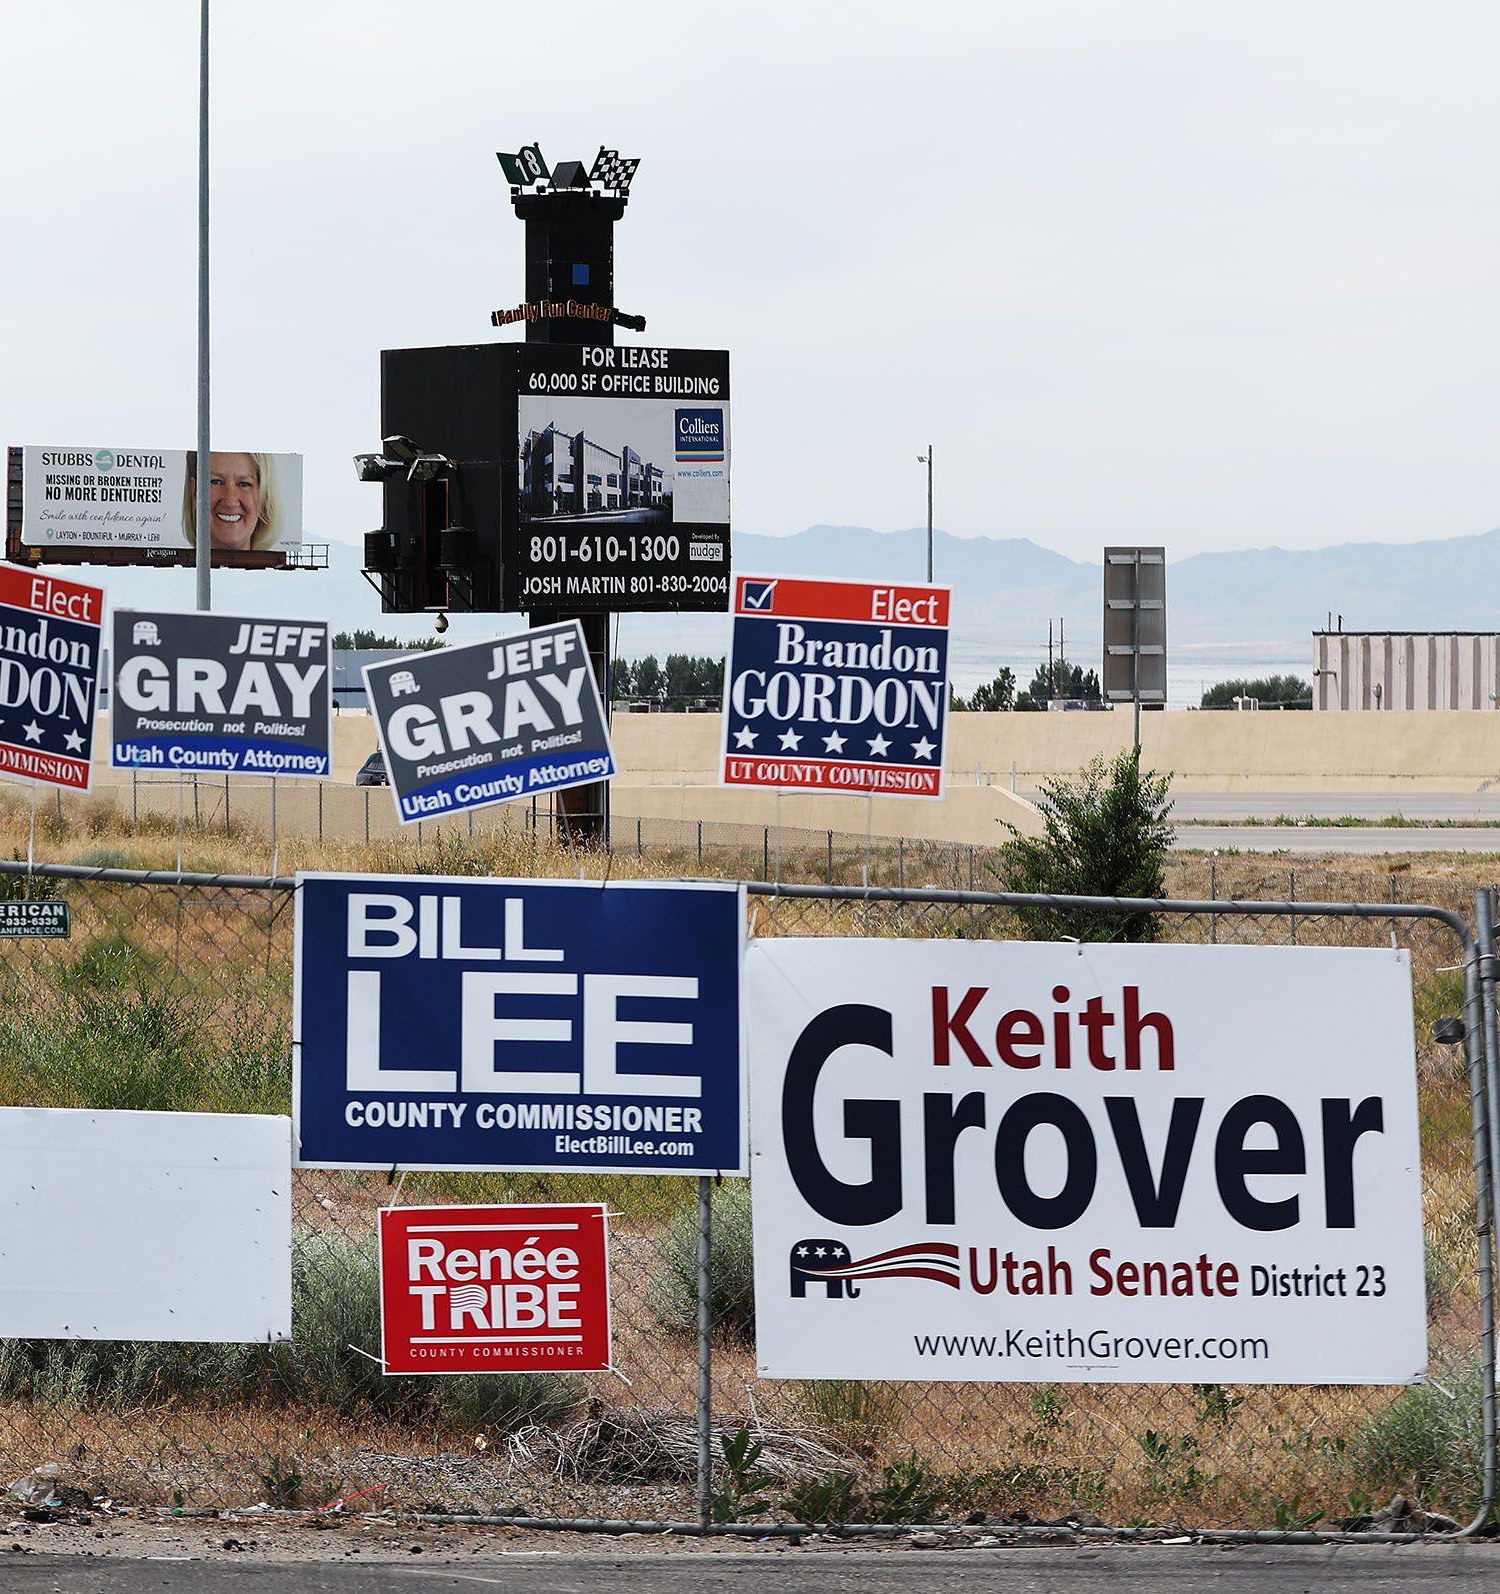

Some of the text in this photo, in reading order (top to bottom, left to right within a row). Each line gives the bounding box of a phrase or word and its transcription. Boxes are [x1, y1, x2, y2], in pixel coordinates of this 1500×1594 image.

[515, 150, 541, 182] 18
[541, 300, 565, 317] Fun
[567, 299, 611, 321] Center
[582, 347, 668, 369] FOR LEASE
[529, 373, 720, 394] 60,000 SF OFFICE BUILDING
[680, 417, 719, 434] Colliers
[42, 453, 166, 469] STUBBS DENTAL
[46, 474, 163, 488] MISSING OR BROKEN TEETH?
[46, 487, 162, 503] NO MORE DENTURES!
[40, 510, 166, 527] Smile with confidence again!
[56, 531, 78, 540] LAYTON
[82, 532, 113, 541] BOUNTIFUL
[118, 533, 142, 541] MURRAY
[530, 536, 680, 562] 801-610-1300
[690, 544, 721, 559] nudge
[30, 578, 92, 620] Elect
[523, 576, 728, 594] JOSH MARTIN 801-830-2004
[871, 589, 939, 624] Elect
[229, 623, 326, 658] JEFF
[487, 631, 577, 681] JEFF
[774, 623, 940, 674] Brandon
[118, 655, 327, 719] GRAY
[731, 669, 944, 731] GORDON
[136, 717, 306, 737] Prosecution not Politics!
[387, 666, 588, 762] GRAY
[116, 743, 328, 774] Utah County Attorney
[416, 730, 582, 779] Prosecution not Politics!
[402, 756, 610, 816] Utah County Attorney
[730, 761, 936, 791] UT COUNTY COMMISSION
[346, 893, 565, 962] BILL
[346, 970, 702, 1098] LEE
[930, 984, 1176, 1072] Keith
[345, 1101, 703, 1133] COUNTY COMMISSIONER
[781, 1003, 1385, 1233] Grover
[555, 1134, 694, 1156] ElectBillLee.com
[407, 1236, 581, 1282] Renée
[968, 1245, 1387, 1299] Utah Senate District 23
[408, 1283, 583, 1330] TRIBE
[409, 1346, 584, 1358] COUNTY COMMISSIONER
[913, 1328, 1270, 1361] www.KeithGrover.com
